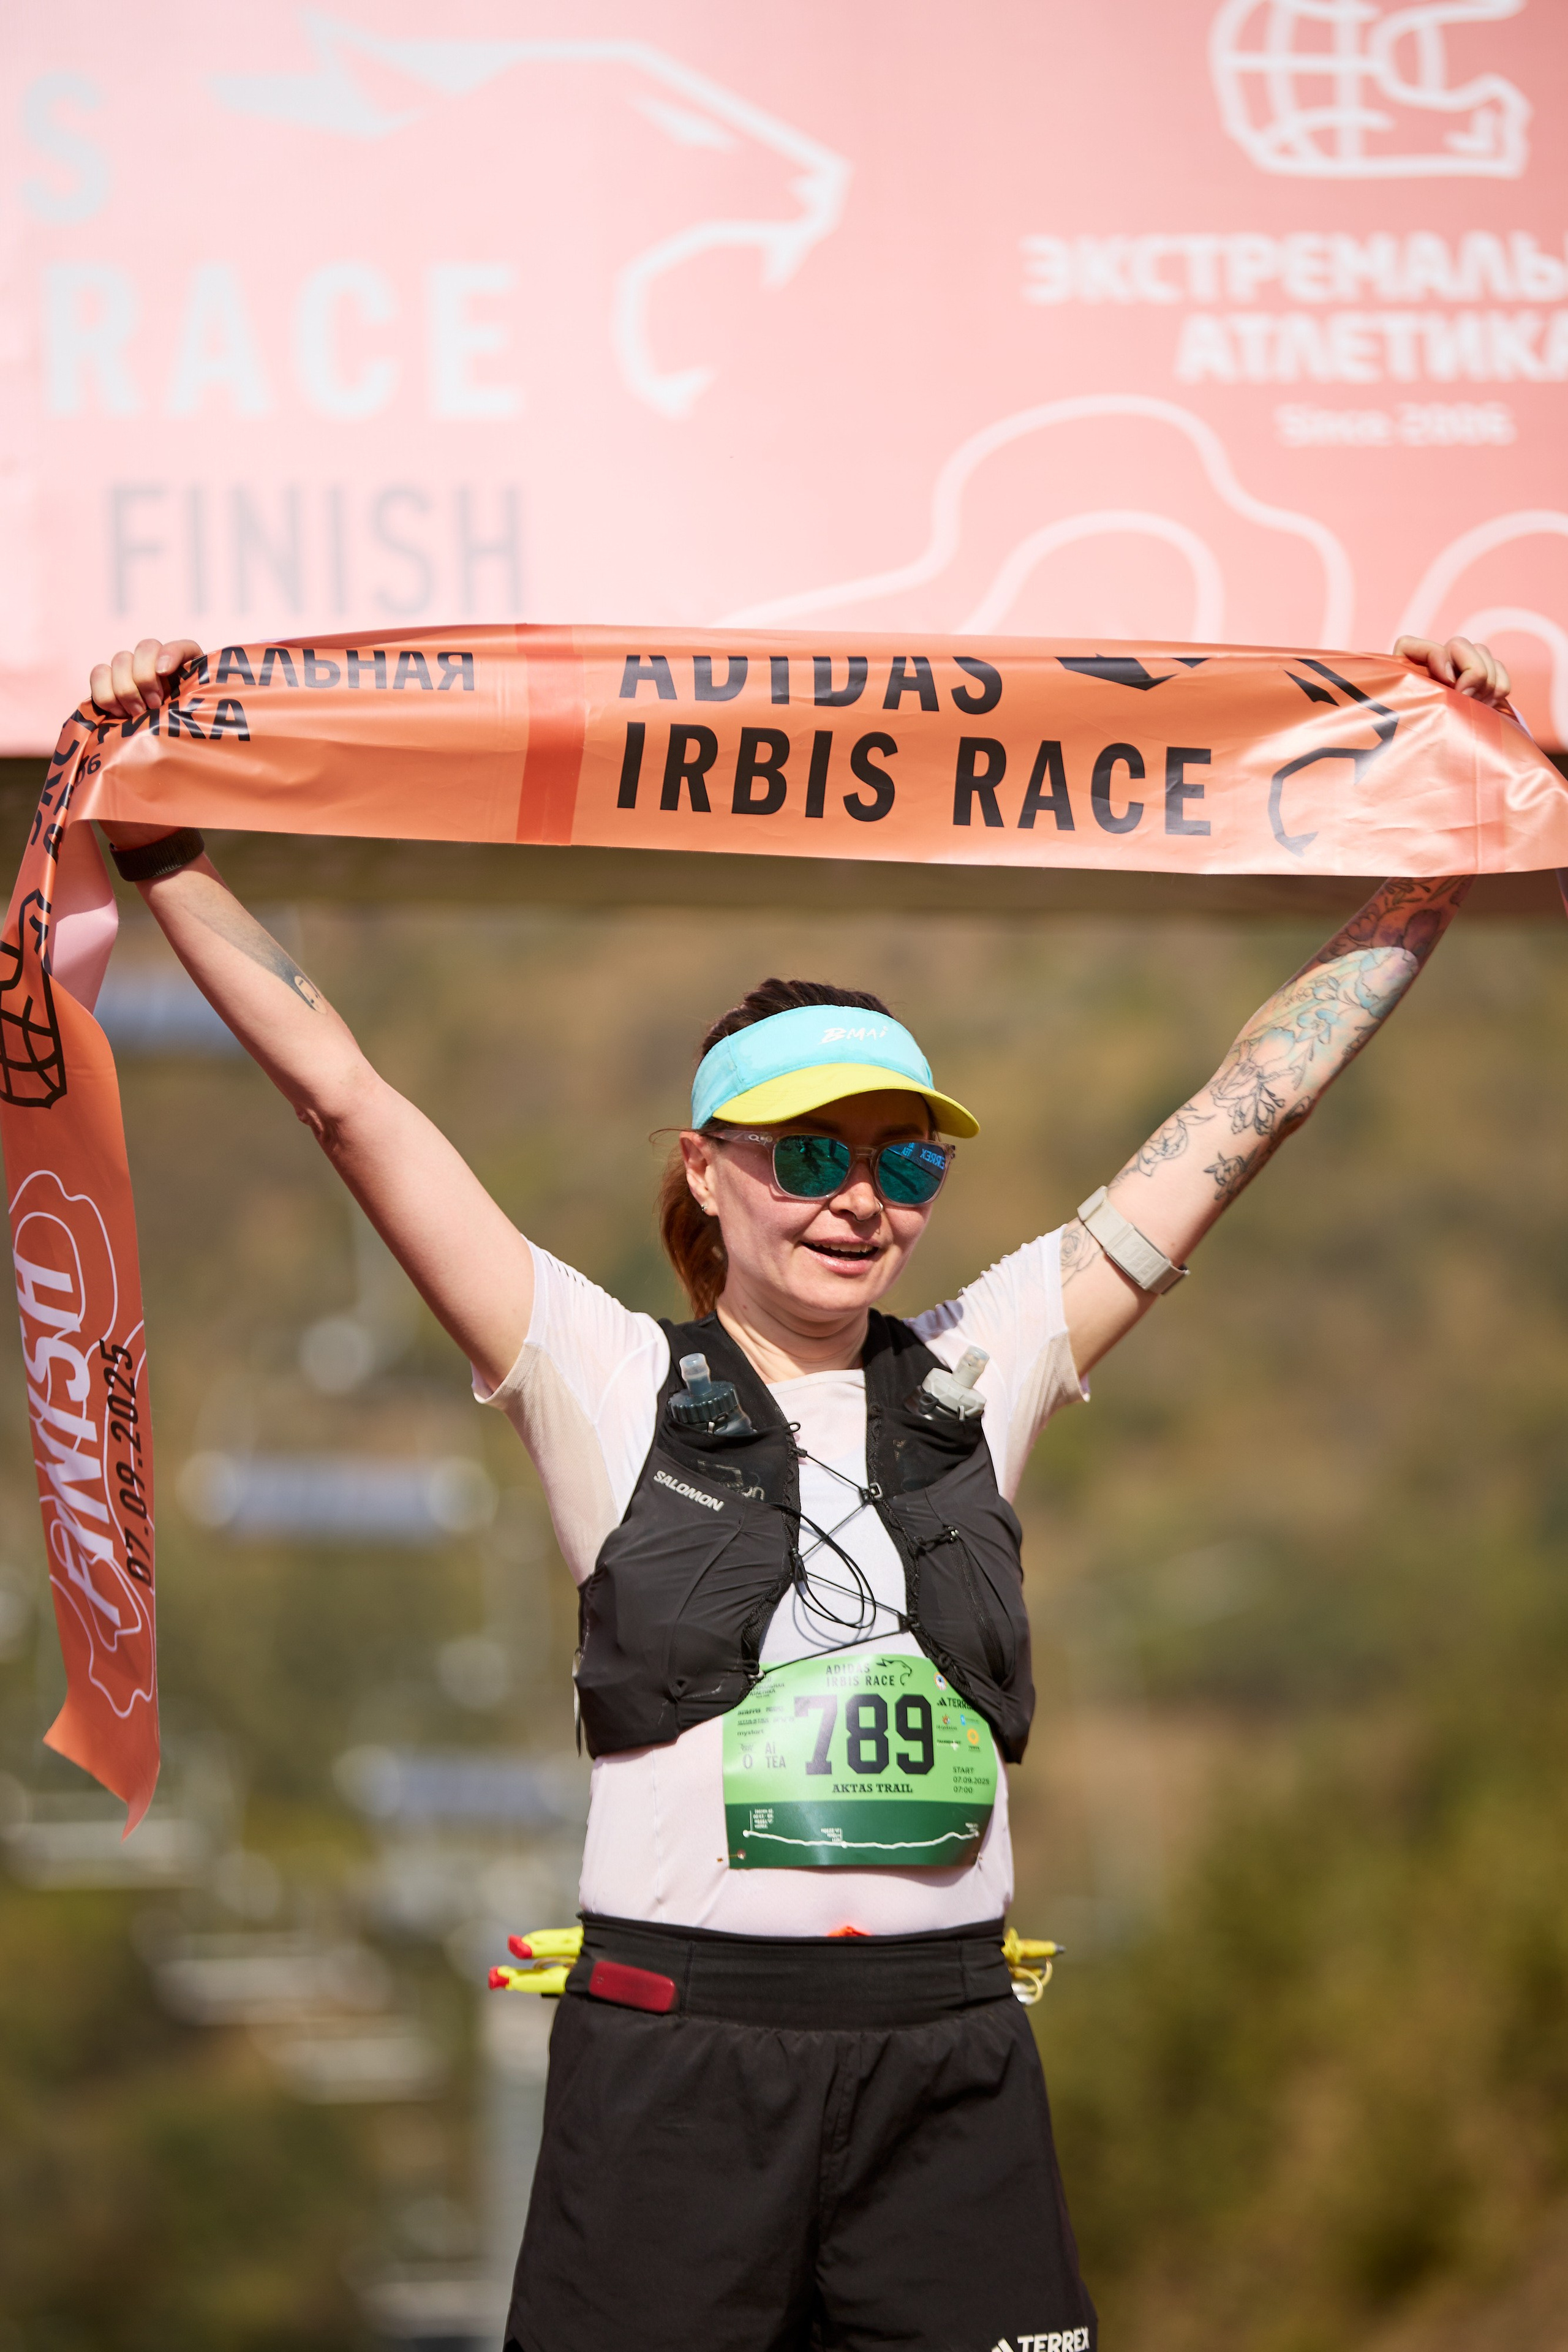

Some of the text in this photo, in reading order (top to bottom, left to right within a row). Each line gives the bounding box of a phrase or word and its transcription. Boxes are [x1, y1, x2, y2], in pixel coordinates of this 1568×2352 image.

[1021, 232, 1568, 303] ЭКСТРЕМАЛЬ
[45, 260, 519, 418] RACE
[110, 481, 524, 616] FINISH
[617, 722, 1212, 837] IRBIS RACE
[13, 1249, 121, 1628] FINISH
[100, 1339, 152, 1588] 07.09.2025
[653, 1470, 725, 1512] SALOMON
[826, 1664, 870, 1675] ADIDAS
[826, 1675, 895, 1687] IRBIS RACE
[765, 1755, 786, 1769] TEA
[794, 1693, 935, 1775] 789
[832, 1783, 913, 1793] AKTAS TRAIL
[1017, 2326, 1090, 2352] TERREX
